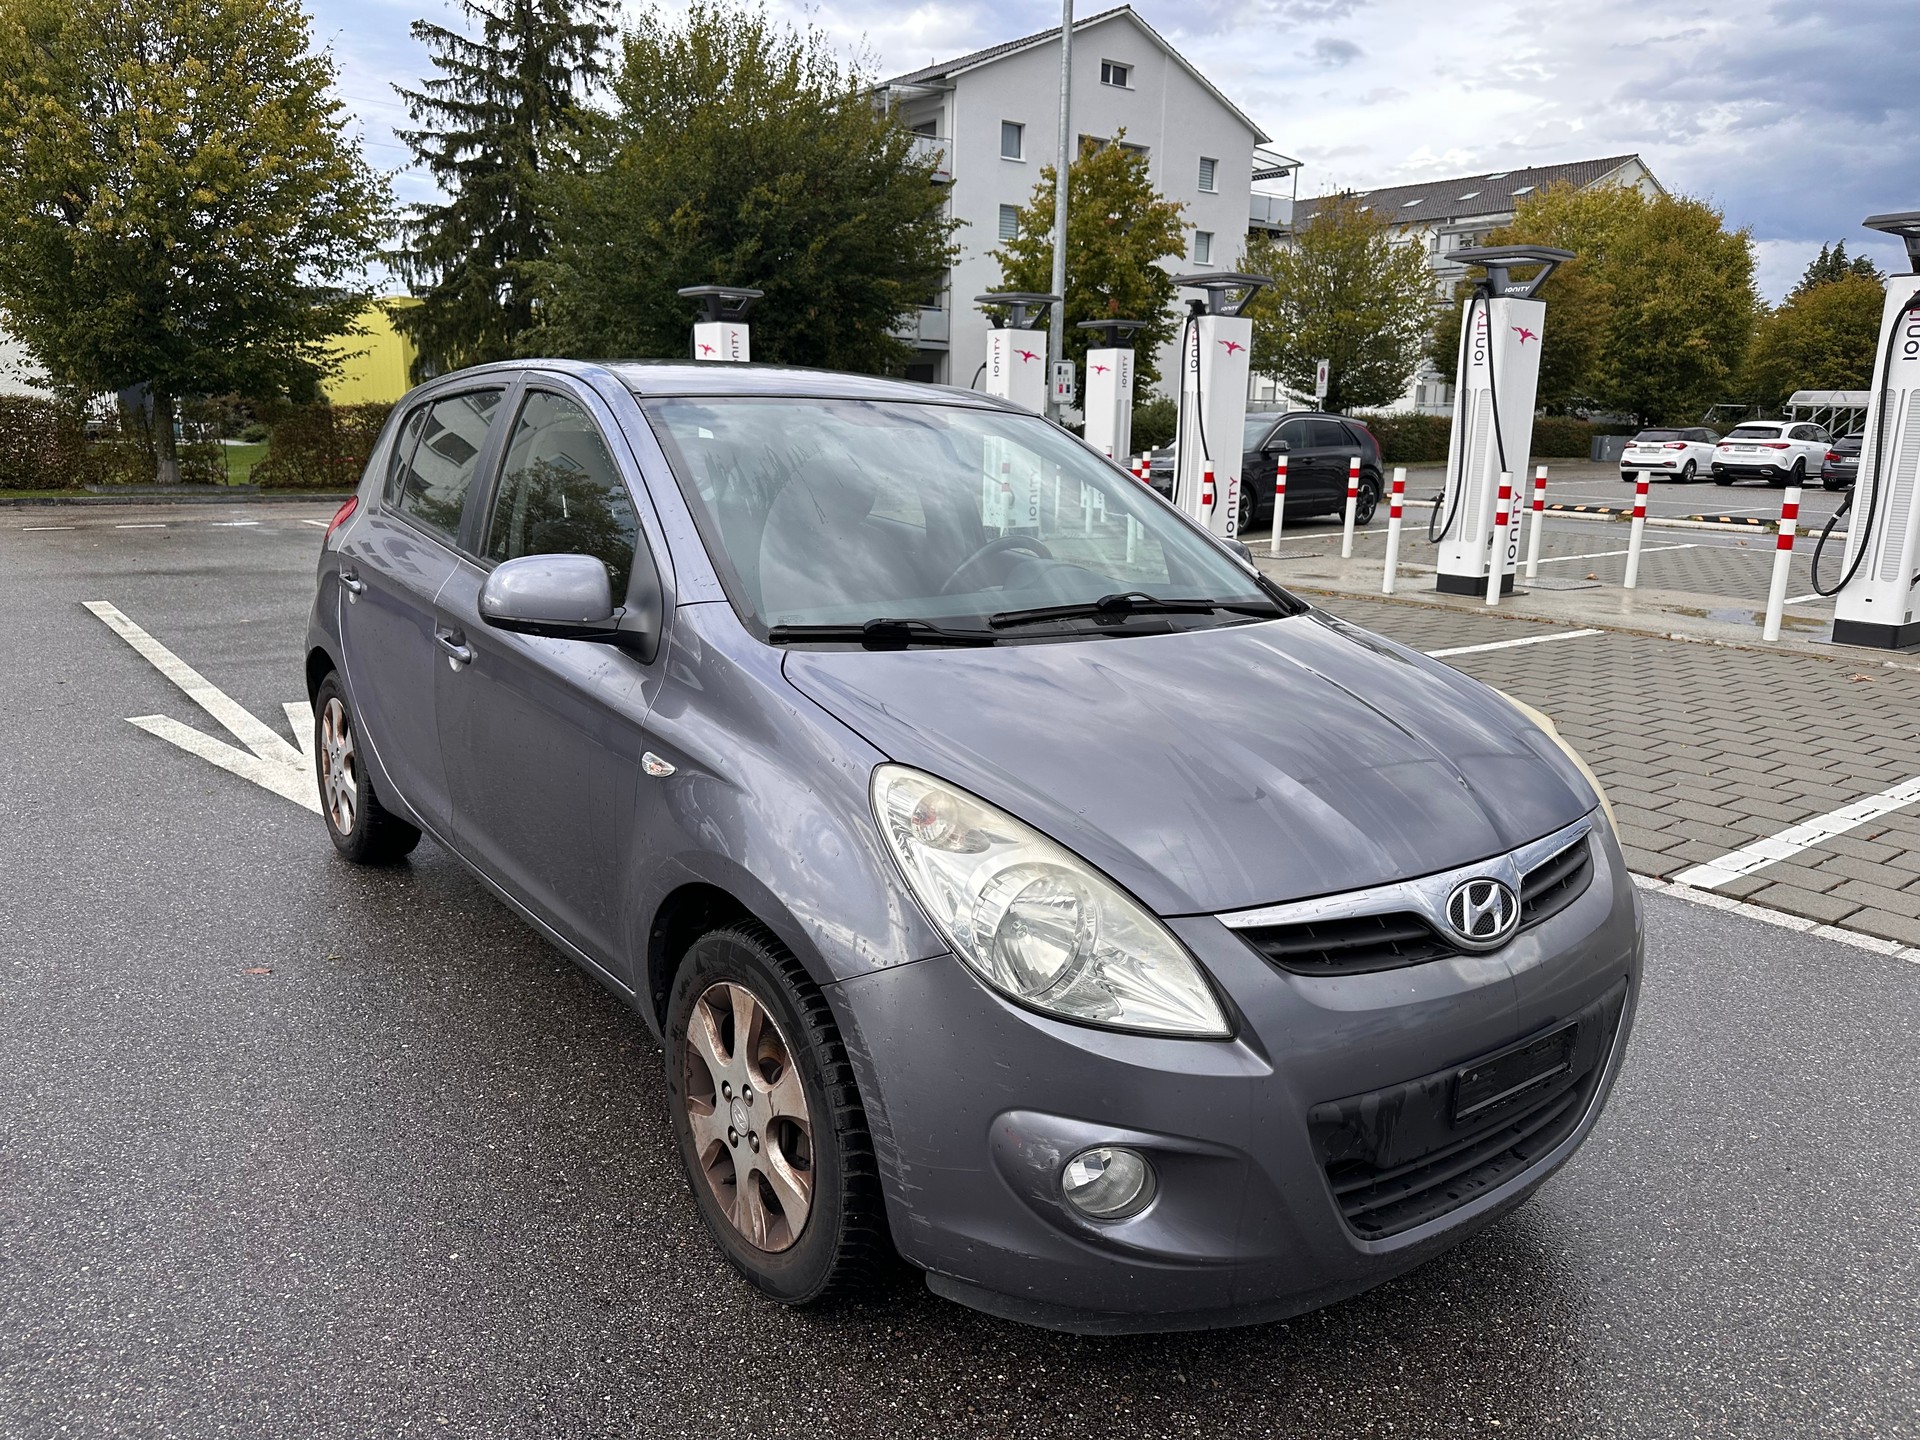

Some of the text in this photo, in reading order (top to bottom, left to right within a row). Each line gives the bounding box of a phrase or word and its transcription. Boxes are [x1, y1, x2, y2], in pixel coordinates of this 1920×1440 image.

[1504, 285, 1531, 293] IONITY
[731, 330, 740, 361] NITY
[1473, 310, 1487, 366] IONITY
[1902, 289, 1920, 361] IONI
[993, 337, 1001, 377] IONITY
[1226, 476, 1238, 538] IONITY
[1507, 491, 1522, 566] IONITY
